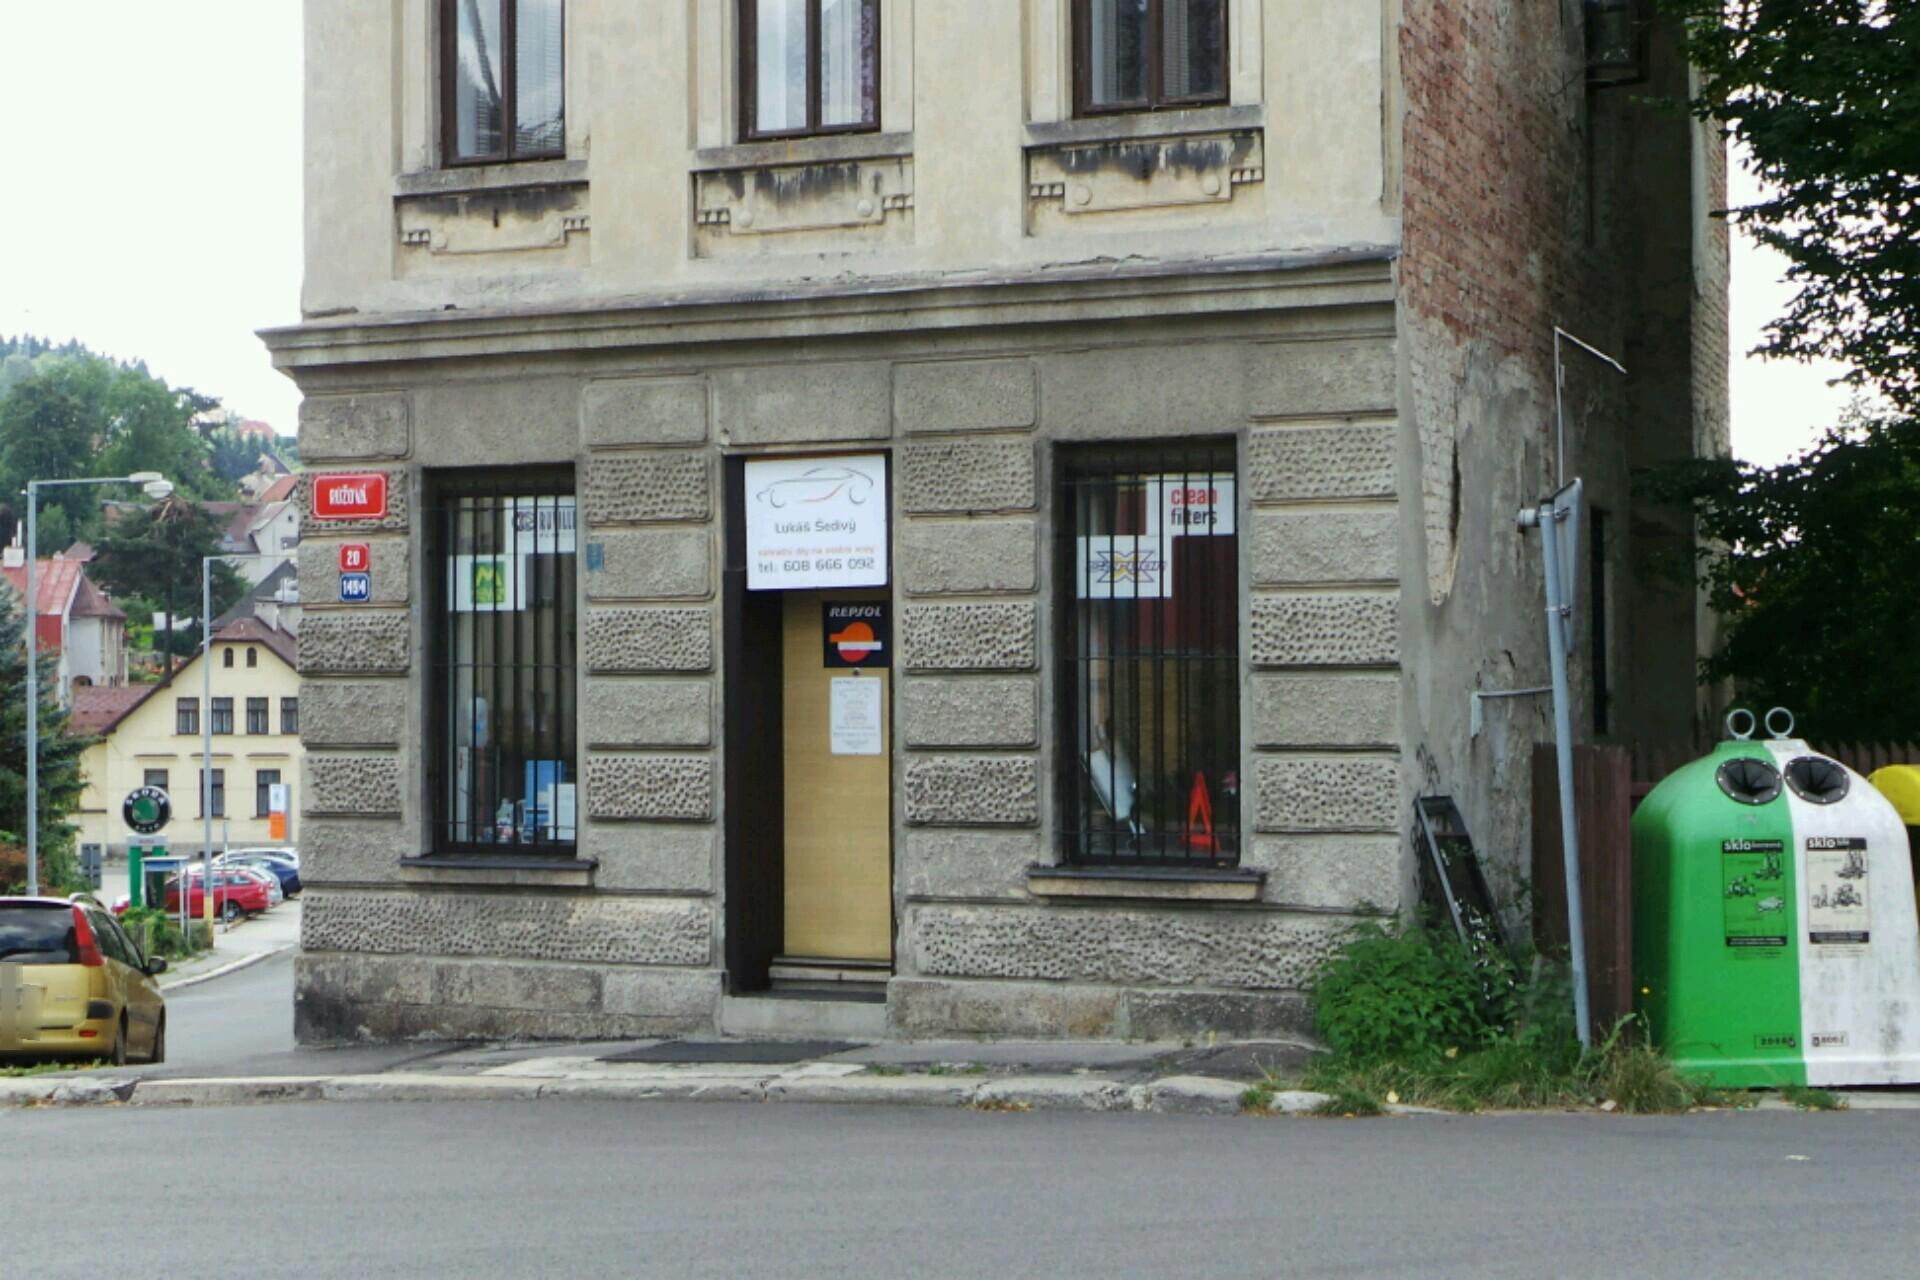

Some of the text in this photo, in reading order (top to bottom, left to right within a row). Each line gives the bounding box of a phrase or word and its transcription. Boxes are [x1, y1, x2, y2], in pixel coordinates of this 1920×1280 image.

[1171, 507, 1217, 525] fiters
[347, 550, 361, 566] 20
[783, 558, 811, 573] 608
[815, 556, 843, 571] 666
[847, 555, 875, 570] 092
[829, 605, 882, 618] REPSOL
